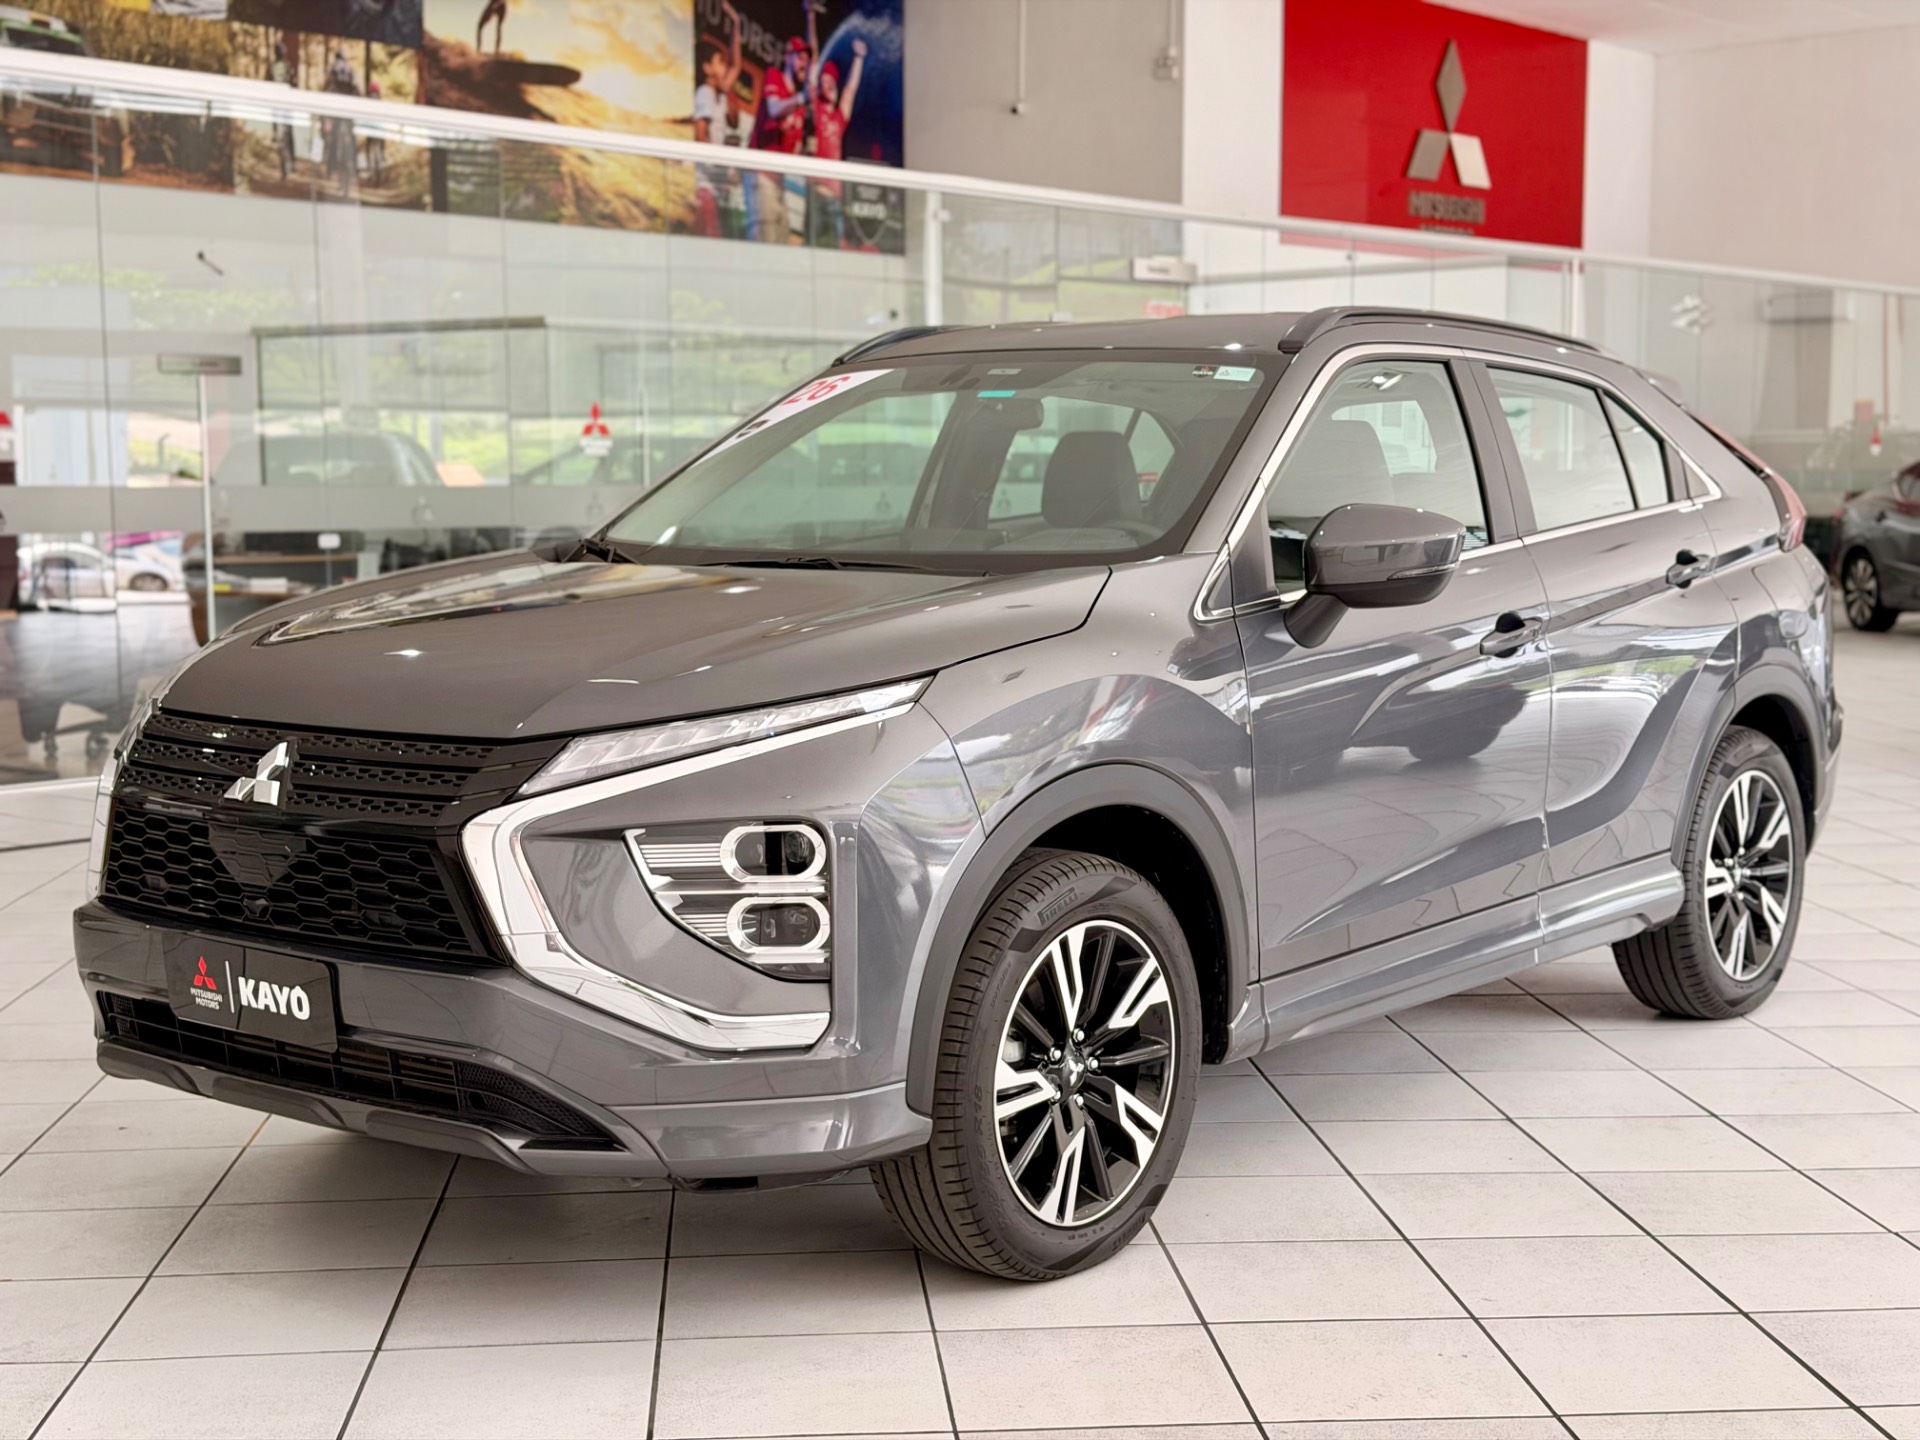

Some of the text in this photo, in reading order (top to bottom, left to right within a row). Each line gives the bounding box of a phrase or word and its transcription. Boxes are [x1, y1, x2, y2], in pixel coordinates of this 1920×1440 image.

[1037, 886, 1078, 926] PIRELLI
[190, 987, 223, 1003] MITSUBISHI
[195, 996, 220, 1010] MOTORS
